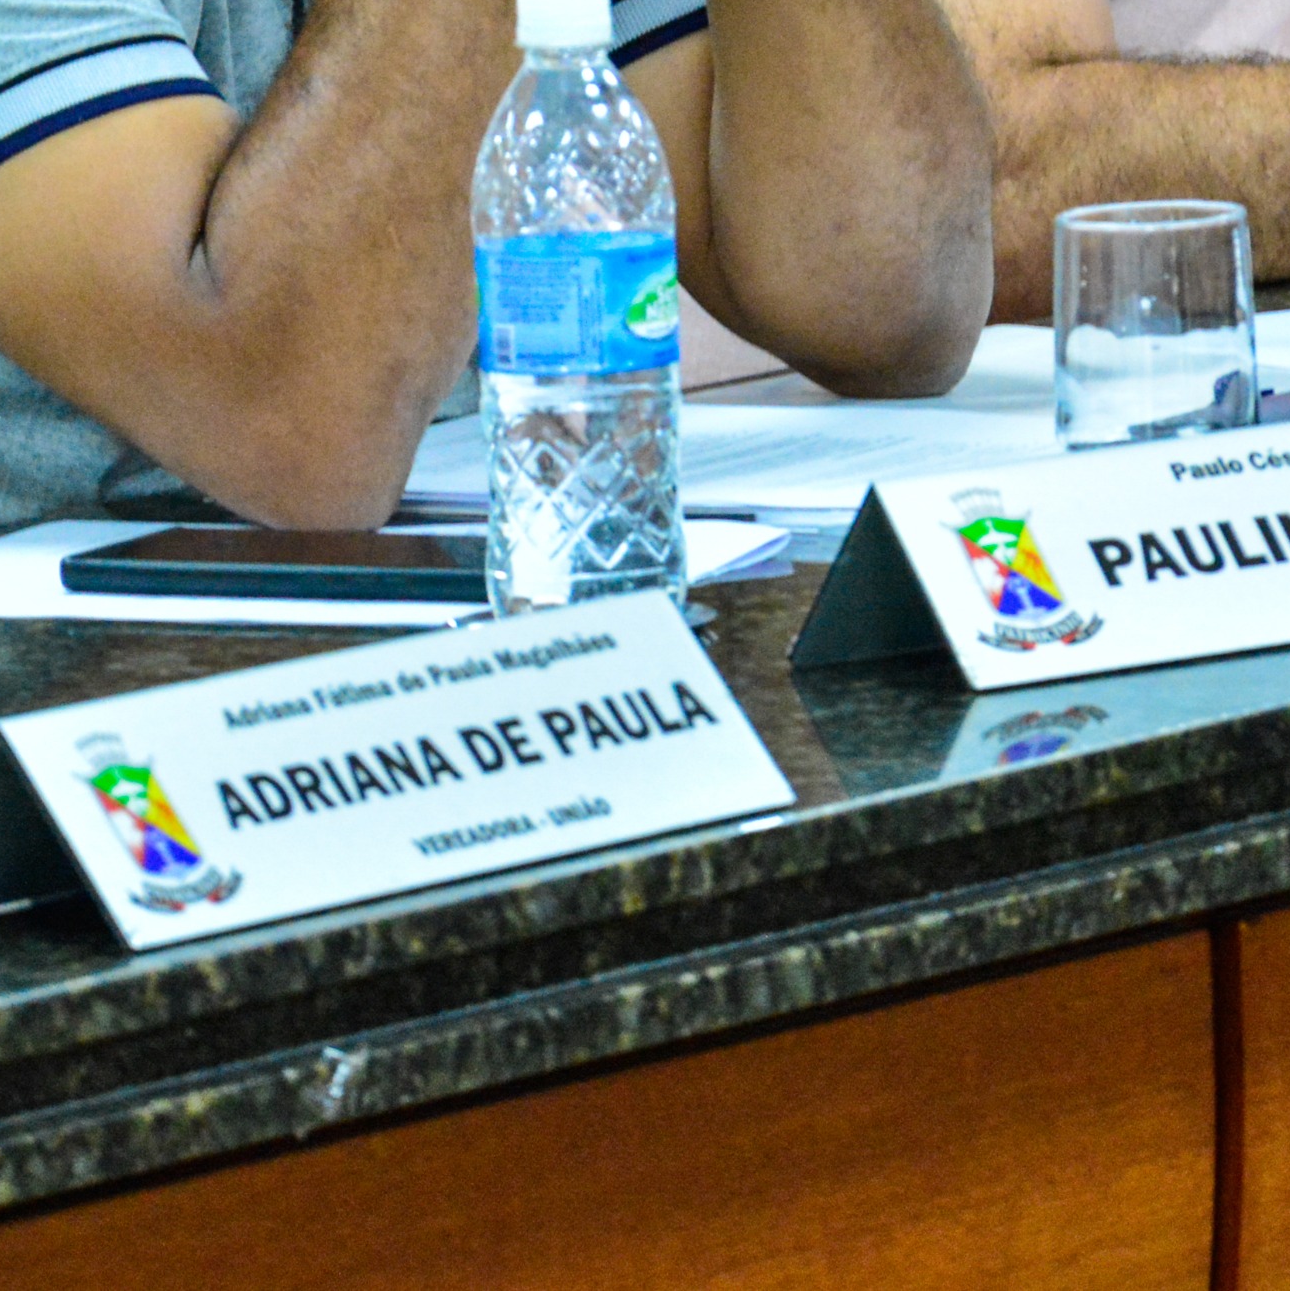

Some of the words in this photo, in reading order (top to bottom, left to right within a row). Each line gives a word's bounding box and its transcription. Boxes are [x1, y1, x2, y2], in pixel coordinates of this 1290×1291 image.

[1169, 455, 1245, 482] Paulo
[223, 696, 314, 729] Adriana
[312, 678, 395, 710] Fátima
[397, 669, 427, 693] de
[427, 656, 493, 684] Paula
[493, 632, 618, 671] Magalhães
[214, 734, 465, 831] ADRIANA
[456, 717, 546, 775] DE
[538, 679, 720, 756] PAULA
[412, 814, 538, 856] VEREADORA
[546, 794, 613, 827] UNIÃO
